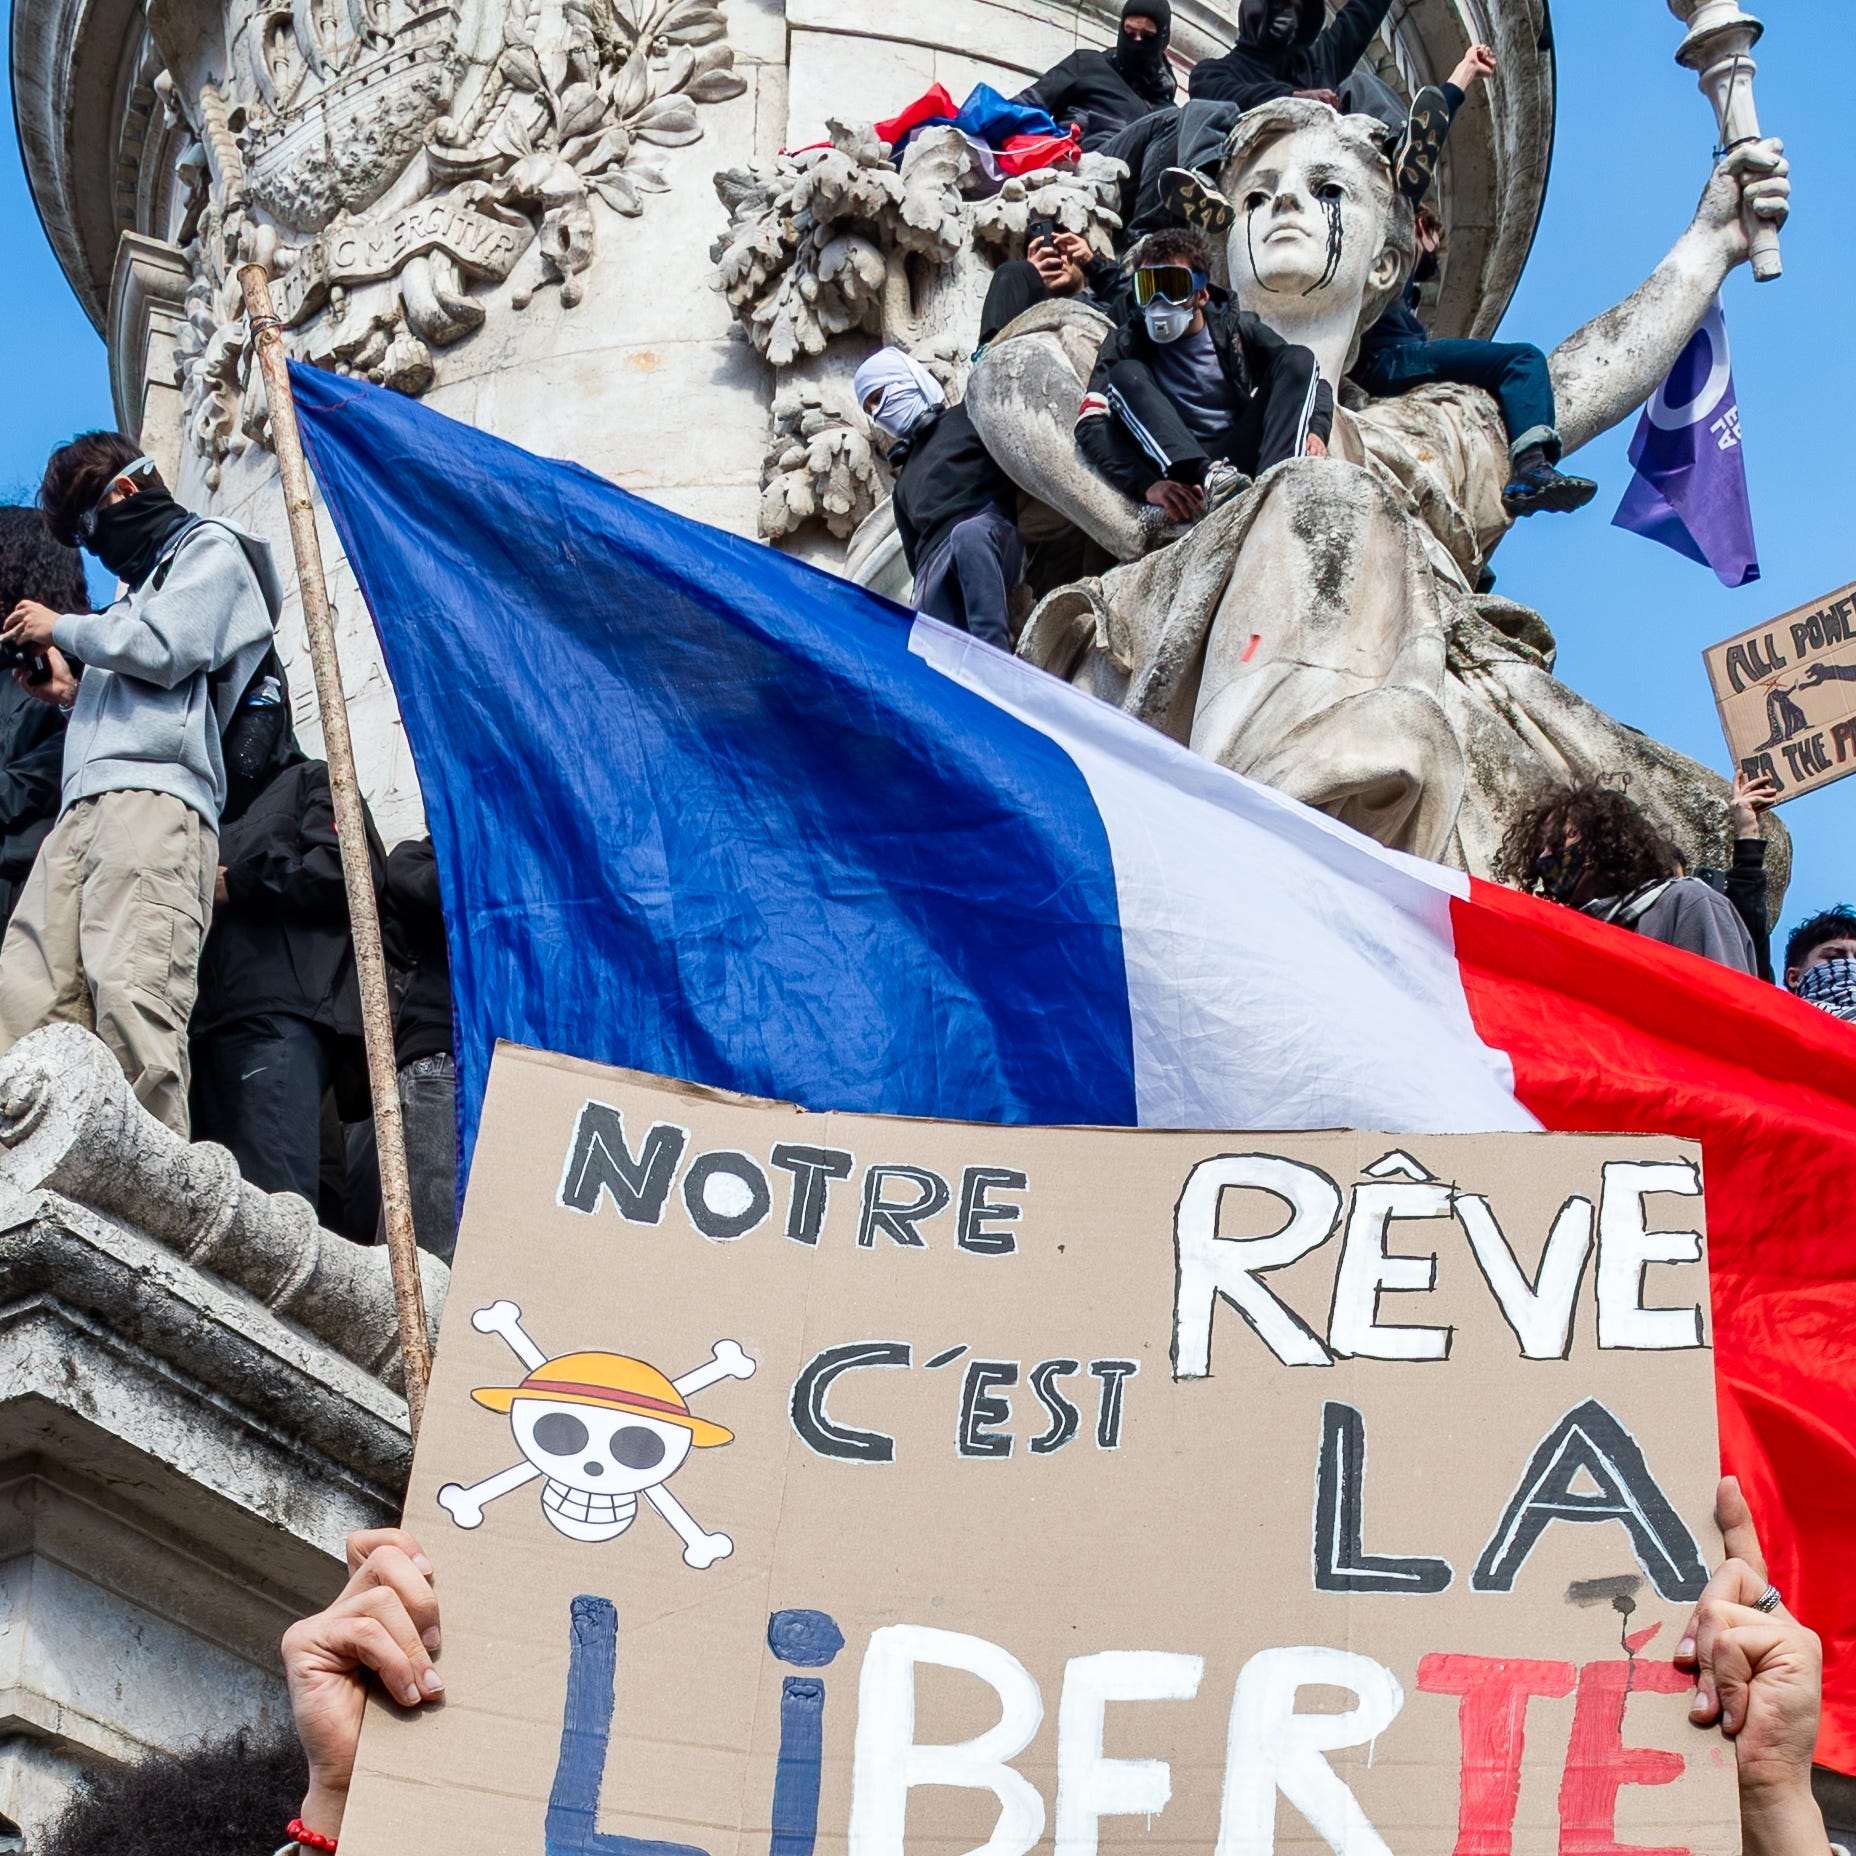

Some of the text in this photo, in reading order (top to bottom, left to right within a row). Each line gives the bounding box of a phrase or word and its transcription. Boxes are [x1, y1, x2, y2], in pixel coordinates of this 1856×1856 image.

[1726, 633, 1787, 694] ALL
[1741, 751, 1785, 792] TO
[1782, 732, 1833, 782] THE
[556, 1100, 1710, 1383] NOTRE RÊVE
[789, 1340, 1710, 1602] C'EST LA
